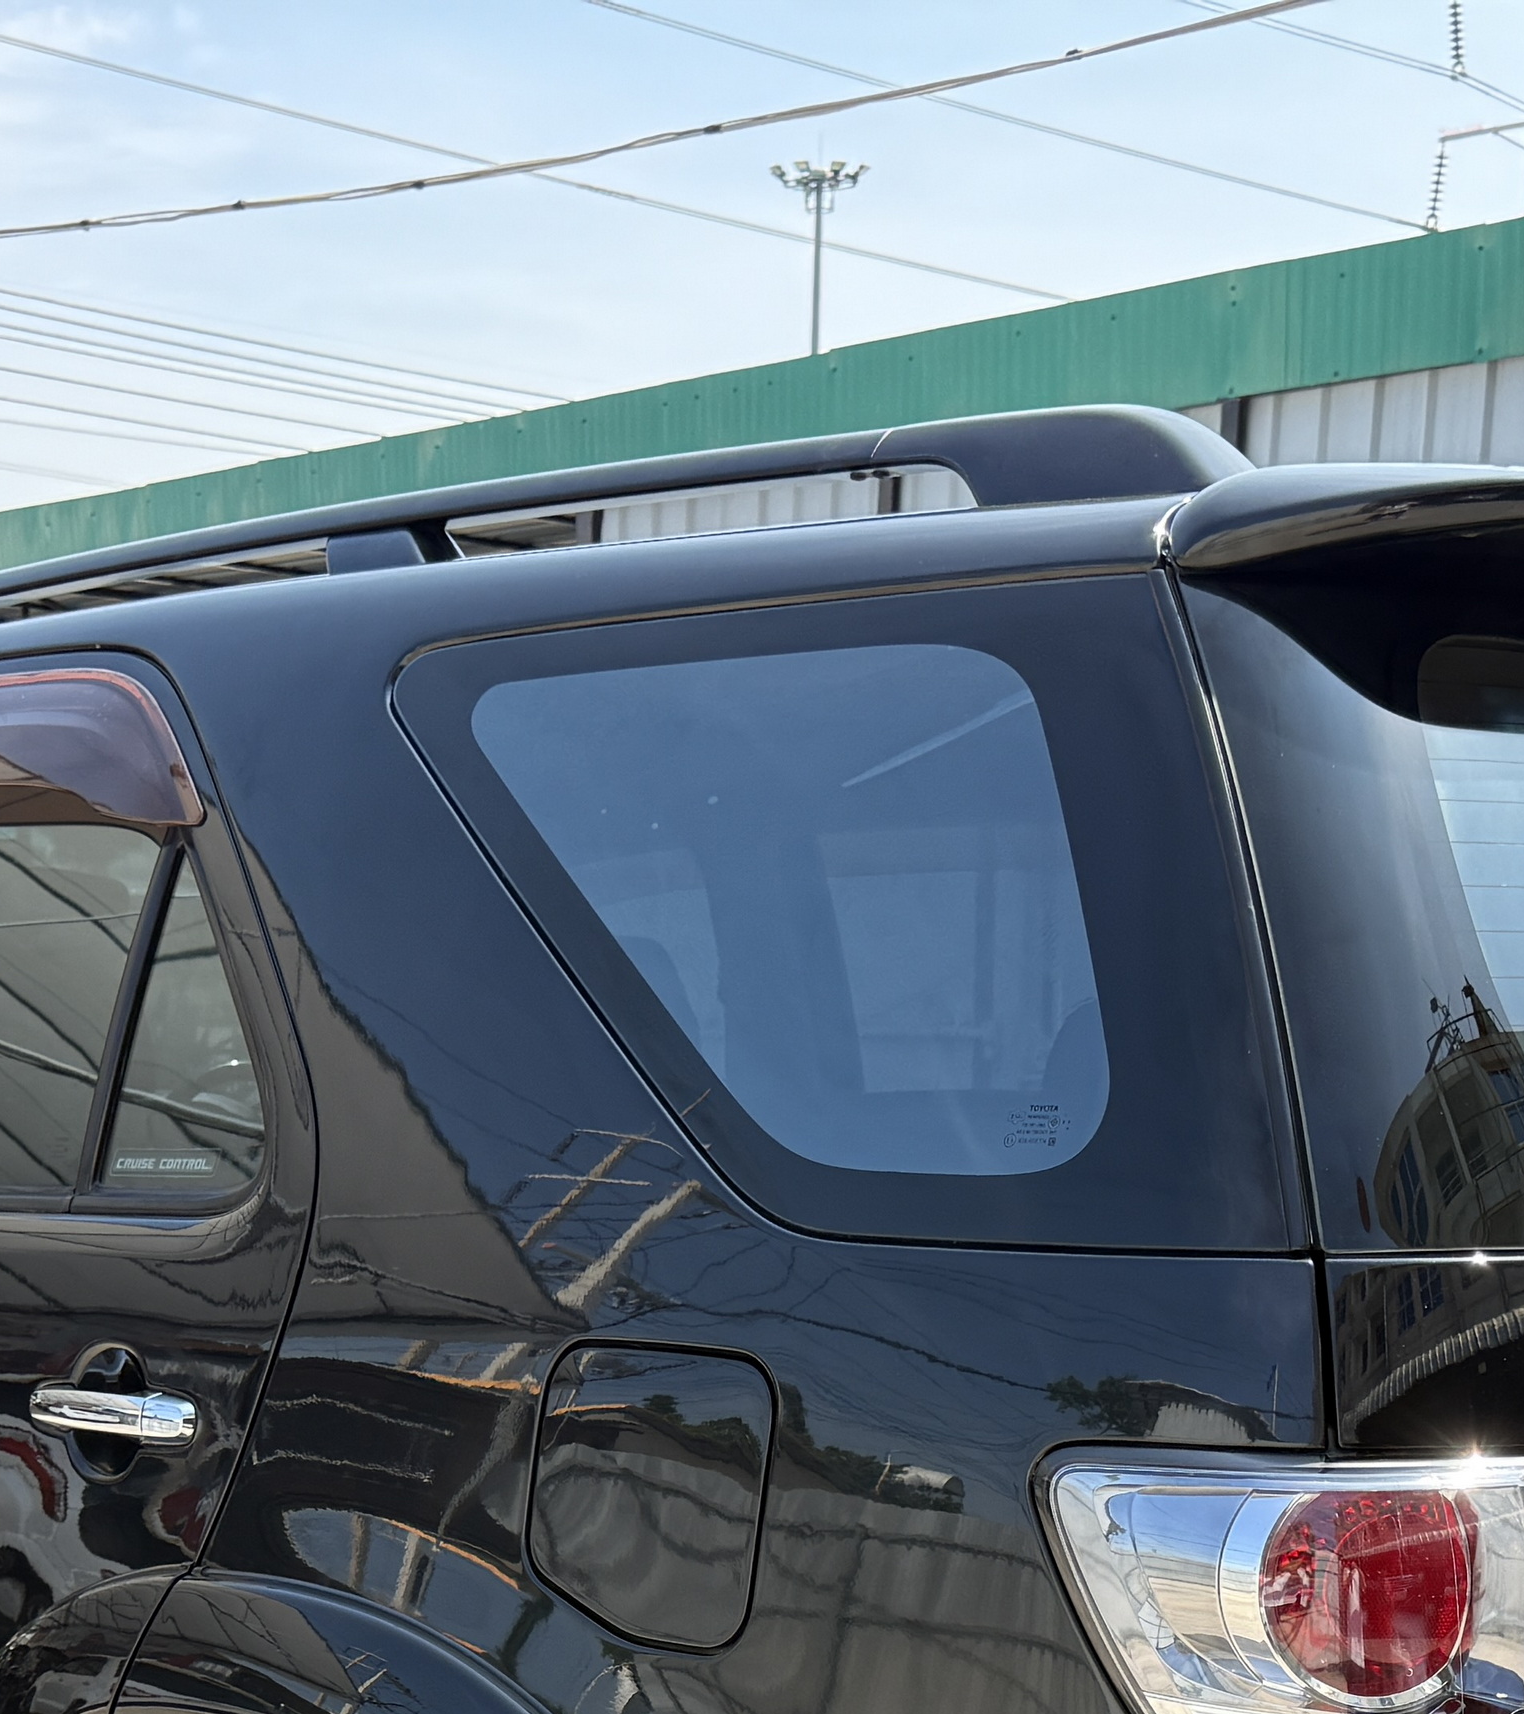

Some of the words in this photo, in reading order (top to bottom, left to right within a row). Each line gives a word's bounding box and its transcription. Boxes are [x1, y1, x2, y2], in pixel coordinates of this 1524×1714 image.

[1030, 1104, 1059, 1112] TOYOTA
[116, 1158, 155, 1169] CRUISE
[159, 1159, 213, 1170] CONTROL
